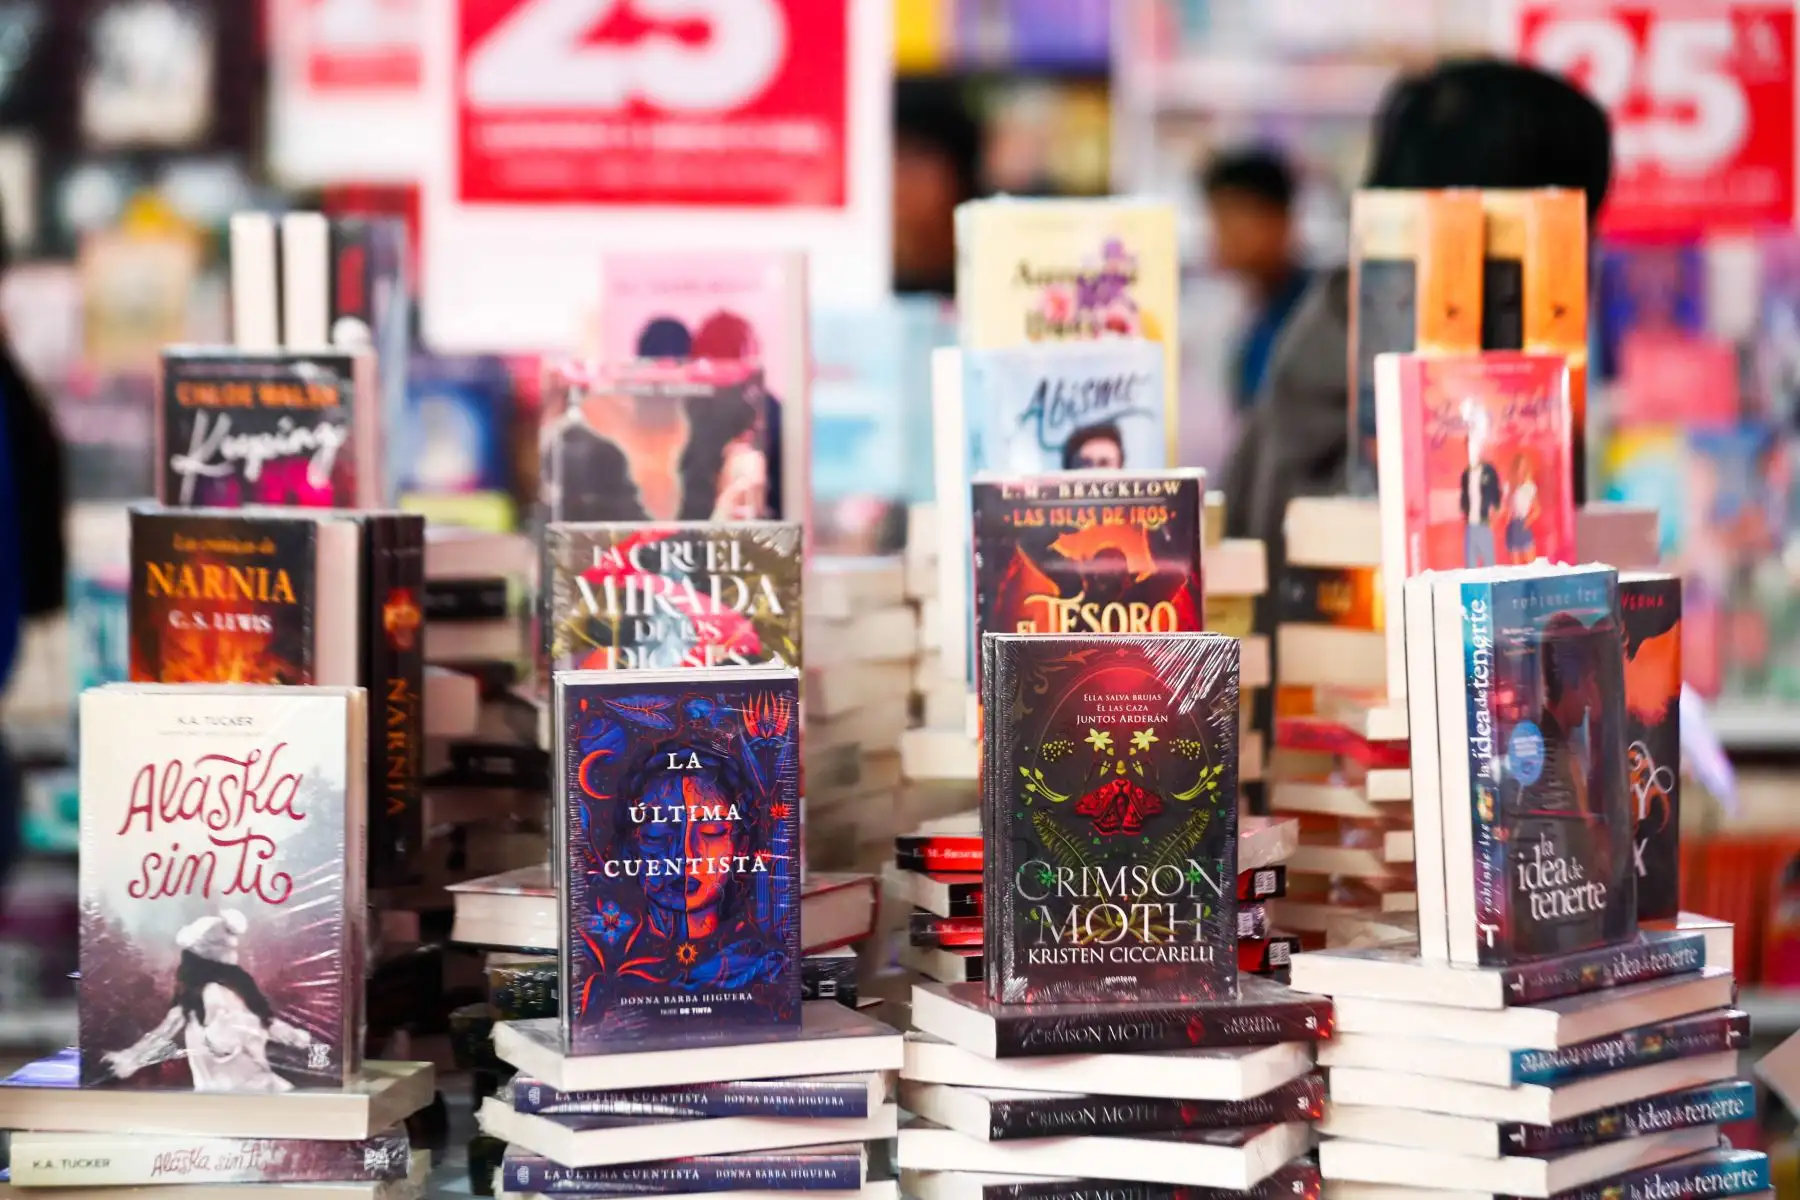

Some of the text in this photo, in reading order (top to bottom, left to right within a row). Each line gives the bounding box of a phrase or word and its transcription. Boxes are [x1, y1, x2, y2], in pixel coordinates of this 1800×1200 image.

[1013, 508, 1045, 526] LAS
[1049, 507, 1097, 528] ISLAS
[1102, 507, 1125, 525] DE
[593, 541, 754, 572] LA CRUEL
[145, 562, 297, 605] NARNIA
[571, 575, 785, 619] MIRADA
[212, 612, 274, 633] LEWIS
[204, 716, 254, 726] TUCKER
[385, 677, 410, 817] NARNIA
[666, 752, 703, 770] LA
[116, 742, 307, 836] Alaska
[628, 802, 742, 823] ÚLTIMA
[1538, 832, 1555, 857] la
[127, 827, 293, 905] sin ti
[603, 856, 768, 878] CUENTISTA
[1516, 843, 1585, 892] idea de
[1015, 858, 1225, 901] CRIMSON
[1528, 881, 1607, 921] tenerte
[1036, 903, 1206, 946] MOTH
[1028, 946, 1214, 964] KRISTEN CICCARELLI
[620, 992, 753, 1005] DONNA BARBA HIGUERA
[554, 1091, 572, 1102] LA
[632, 1091, 710, 1105] CUENTISTA
[724, 1094, 760, 1105] DONNA
[762, 1095, 796, 1105] BARBA
[798, 1095, 845, 1107] HIGUERA
[61, 1158, 111, 1170] TUCKER
[543, 1169, 560, 1180] LA
[622, 1168, 701, 1180] CUENTISTA
[715, 1169, 752, 1179] DONNA
[755, 1169, 788, 1179] BARBA
[790, 1169, 838, 1179] HIGUERA
[1693, 1167, 1759, 1194] tenerte
